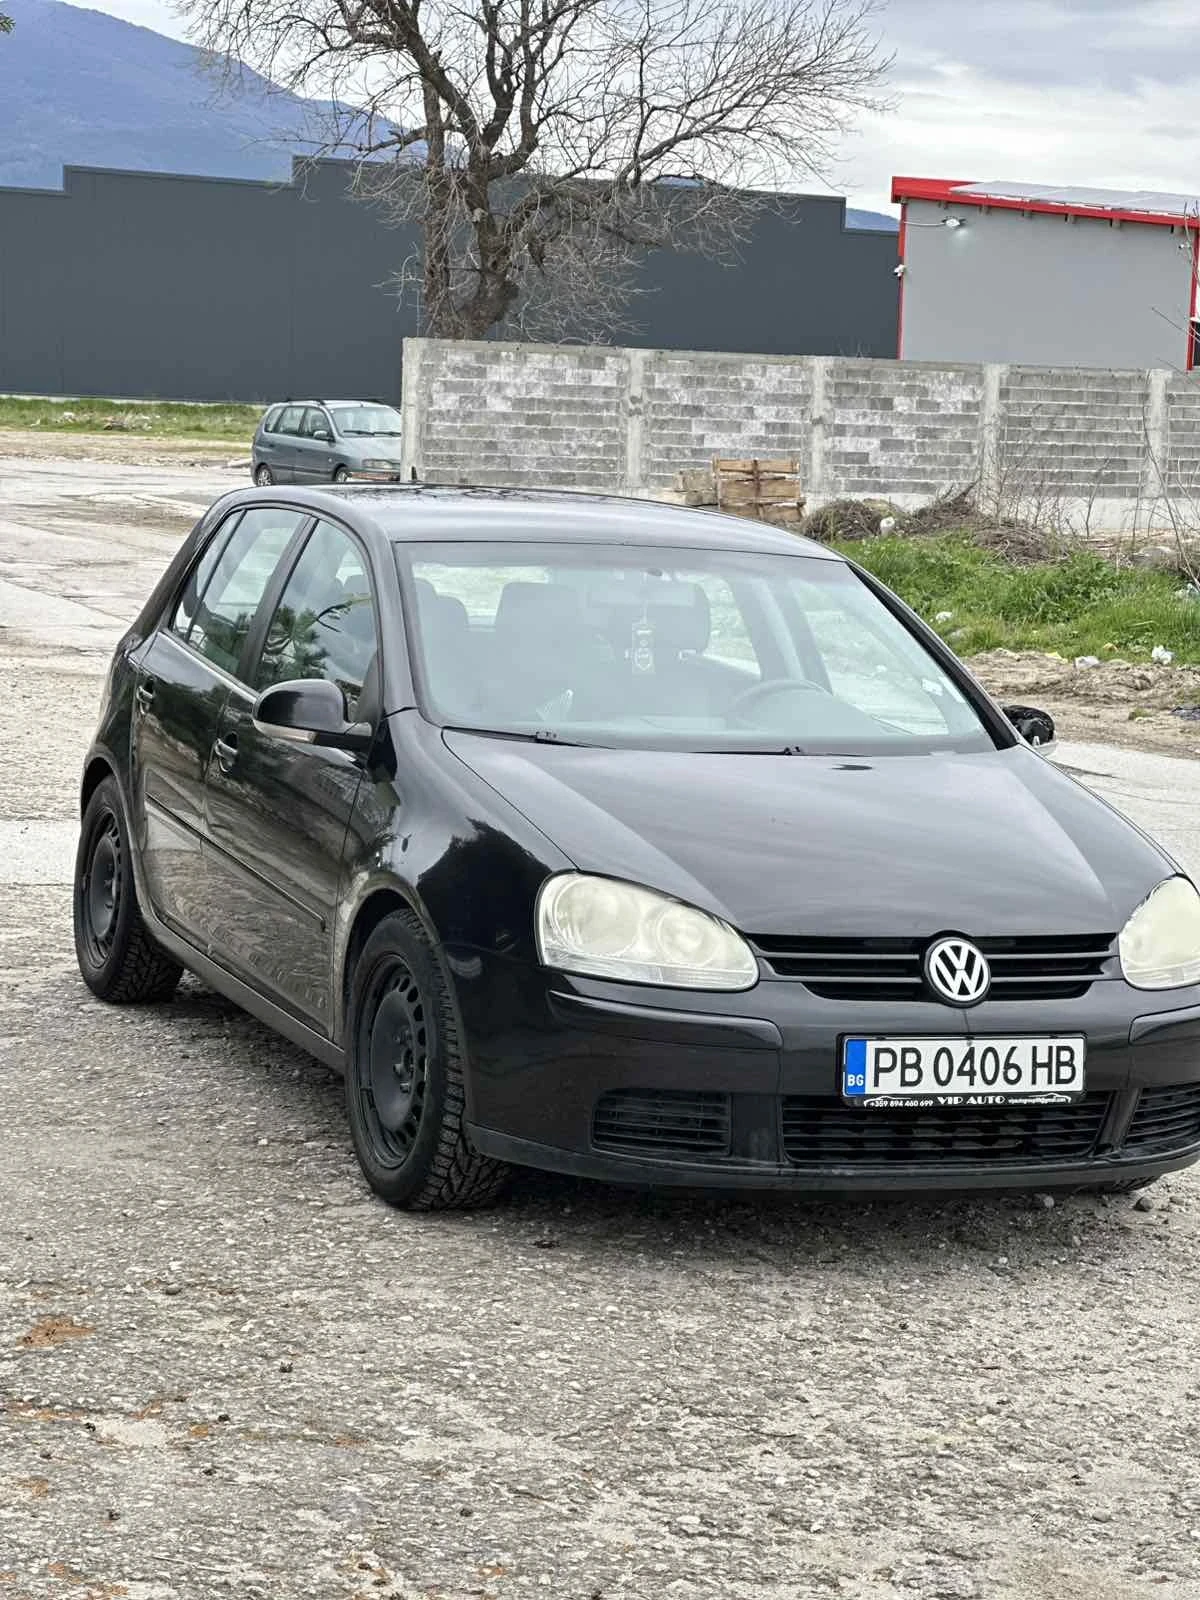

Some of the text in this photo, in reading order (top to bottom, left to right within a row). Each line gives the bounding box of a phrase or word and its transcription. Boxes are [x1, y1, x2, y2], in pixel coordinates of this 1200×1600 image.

[874, 1045, 1077, 1087] PB 0406 HB
[847, 1074, 865, 1087] BG
[937, 1096, 964, 1105] VIP
[966, 1095, 1006, 1104] AUTO
